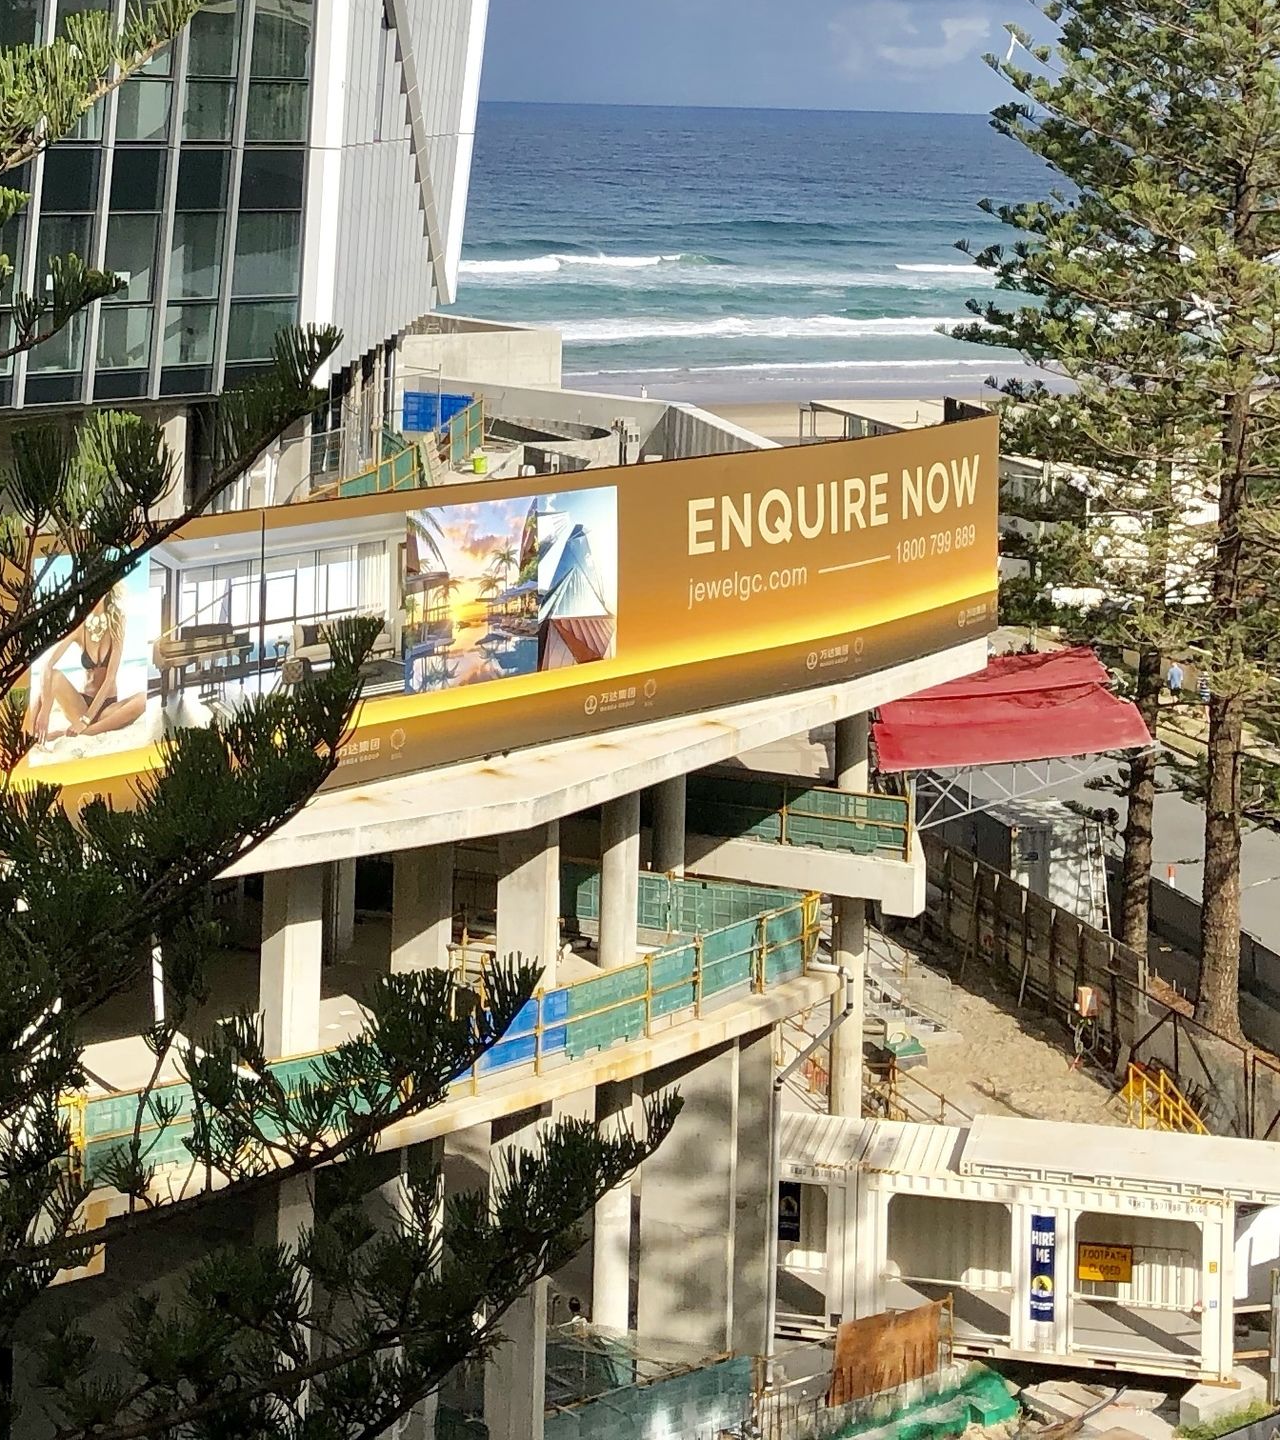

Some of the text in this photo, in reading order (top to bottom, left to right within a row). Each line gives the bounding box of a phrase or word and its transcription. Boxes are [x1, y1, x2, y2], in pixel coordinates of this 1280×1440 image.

[688, 454, 980, 556] ENQUIRE NOW
[688, 524, 976, 610] jewelgc.com 1800 799 889
[1031, 1231, 1055, 1247] HIRE
[1036, 1248, 1051, 1263] ME
[1082, 1247, 1127, 1262] FOOTPATH
[1088, 1263, 1122, 1275] CLOSED
